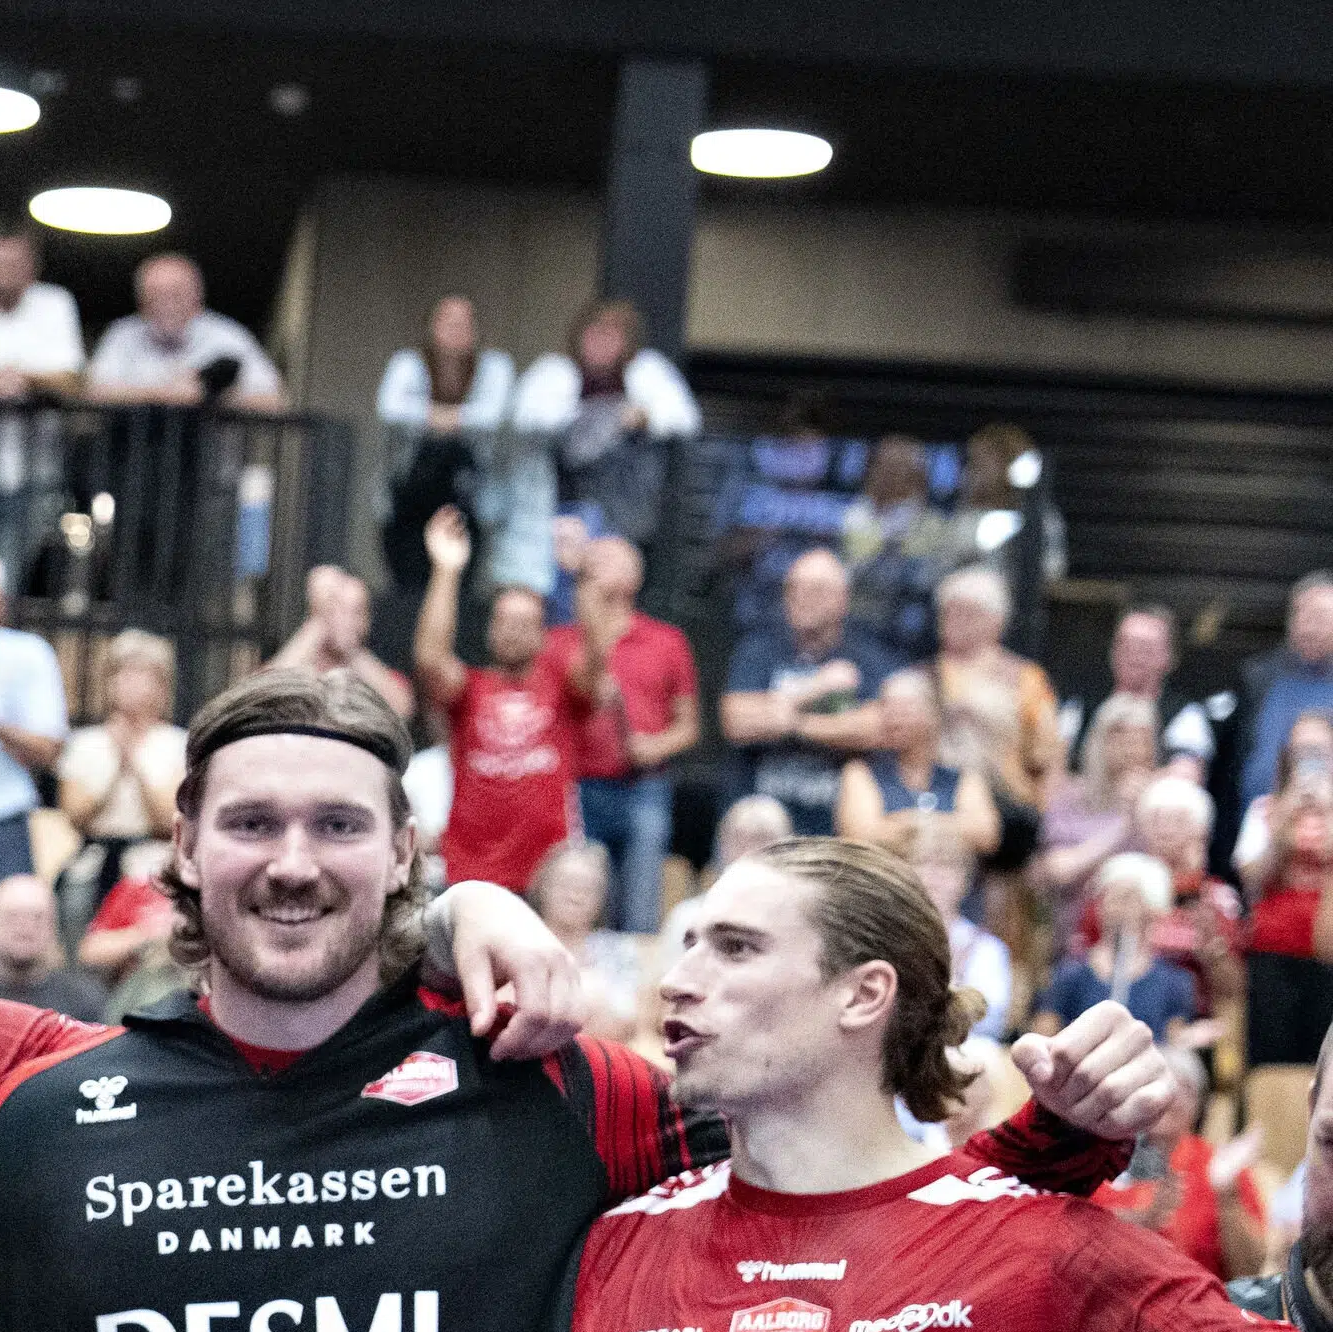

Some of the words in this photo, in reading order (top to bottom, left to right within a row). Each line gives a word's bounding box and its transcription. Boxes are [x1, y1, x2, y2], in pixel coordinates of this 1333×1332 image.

[85, 1160, 447, 1227] Sparekassen
[157, 1221, 376, 1255] DANMARK
[738, 1311, 825, 1331] AALBORG
